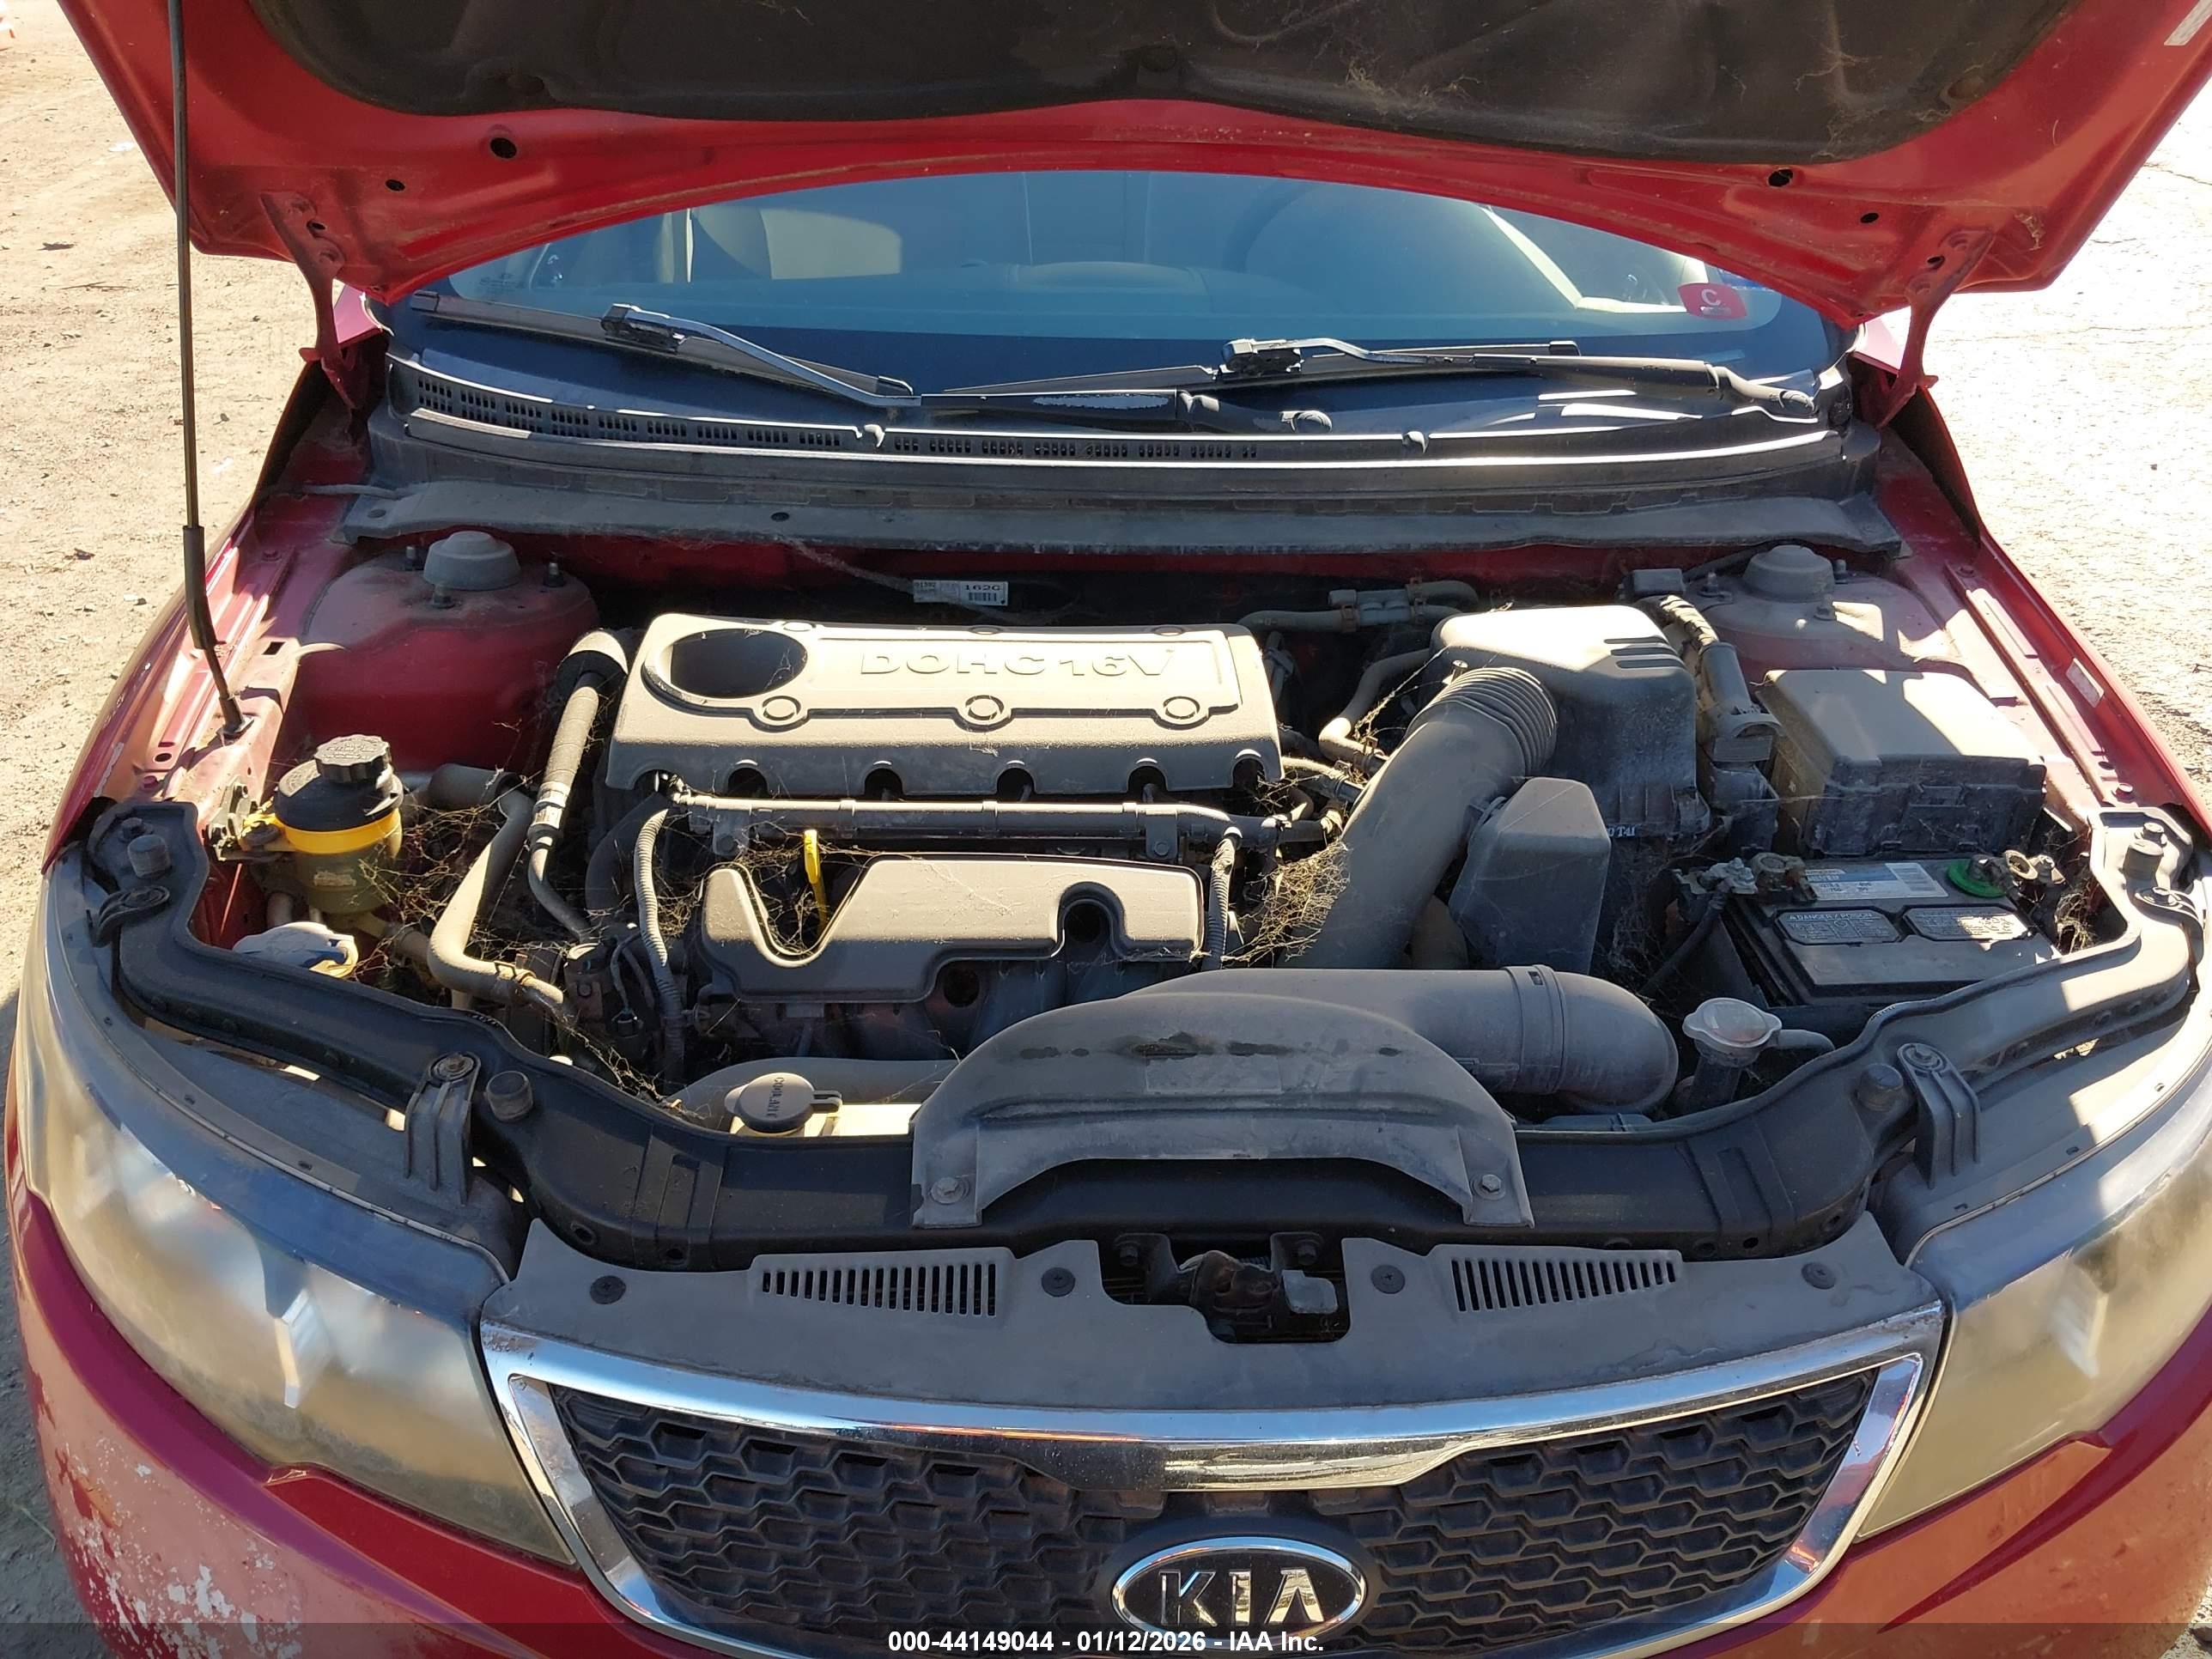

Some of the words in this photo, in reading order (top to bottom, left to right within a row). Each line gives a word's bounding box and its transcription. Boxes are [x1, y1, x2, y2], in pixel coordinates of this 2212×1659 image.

[1701, 289, 1722, 307] C
[860, 651, 1045, 676] DOHC
[1059, 649, 1175, 677] 16V
[1159, 1567, 1325, 1626] KIA
